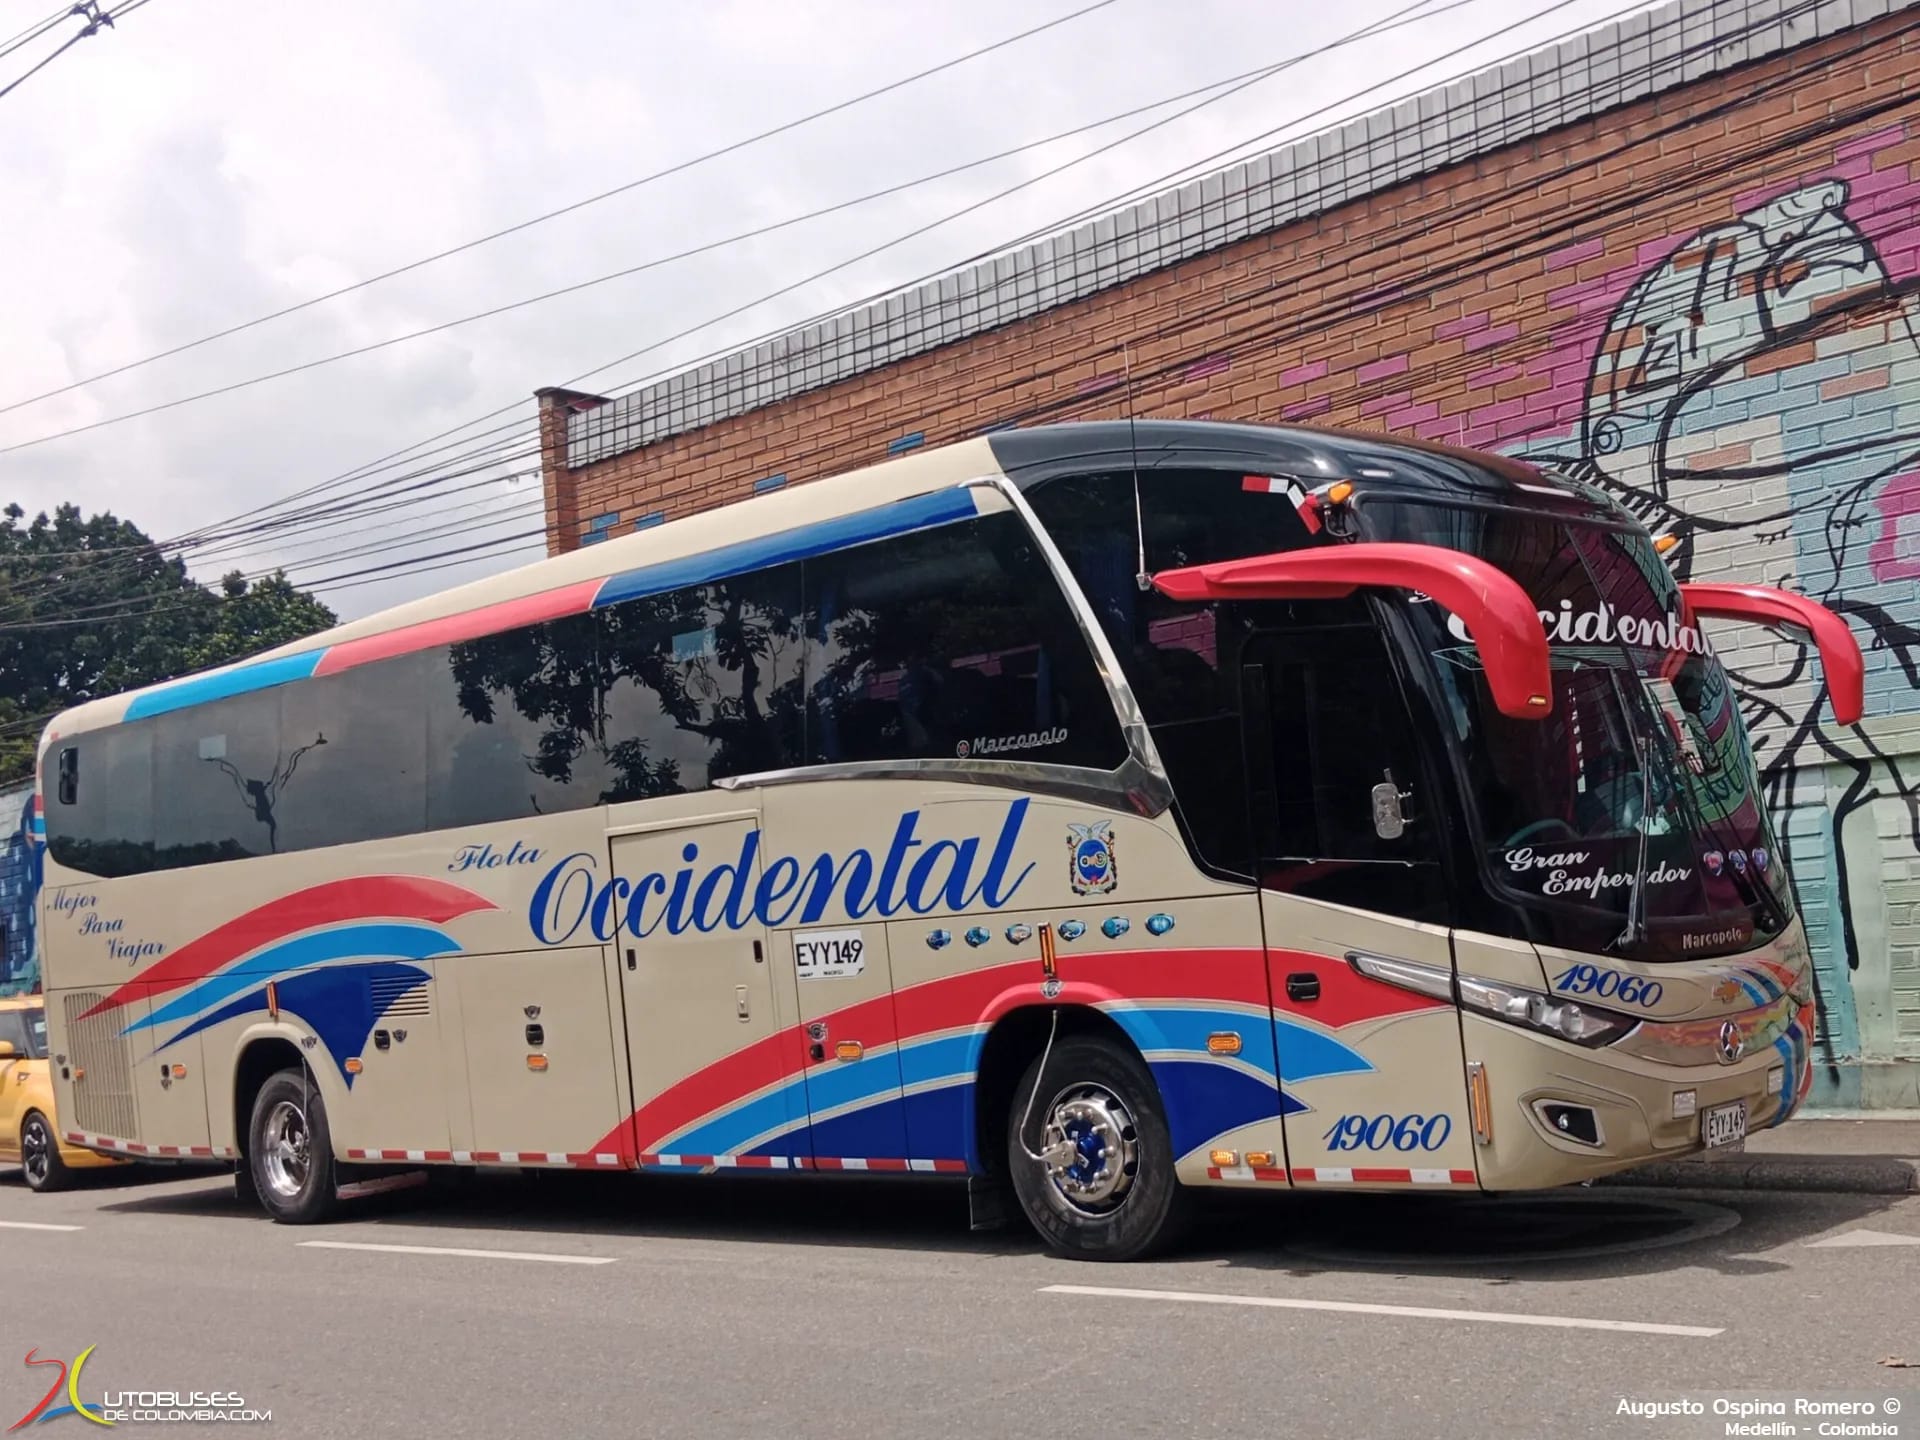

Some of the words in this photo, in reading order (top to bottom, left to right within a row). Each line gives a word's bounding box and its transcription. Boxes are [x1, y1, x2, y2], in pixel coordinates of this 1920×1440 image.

[973, 727, 1068, 754] Marcopolo
[448, 839, 548, 872] Flota
[529, 797, 1036, 946] Occidental
[1505, 847, 1590, 872] Gran
[1542, 861, 1692, 899] Emperdor
[46, 887, 98, 919] Mejor
[78, 912, 124, 936] Para
[1682, 927, 1742, 950] Marcopolo
[108, 937, 167, 968] Viajar
[795, 939, 863, 967] EYY149
[1552, 964, 1663, 1008] 19060
[1322, 1113, 1452, 1152] 19060
